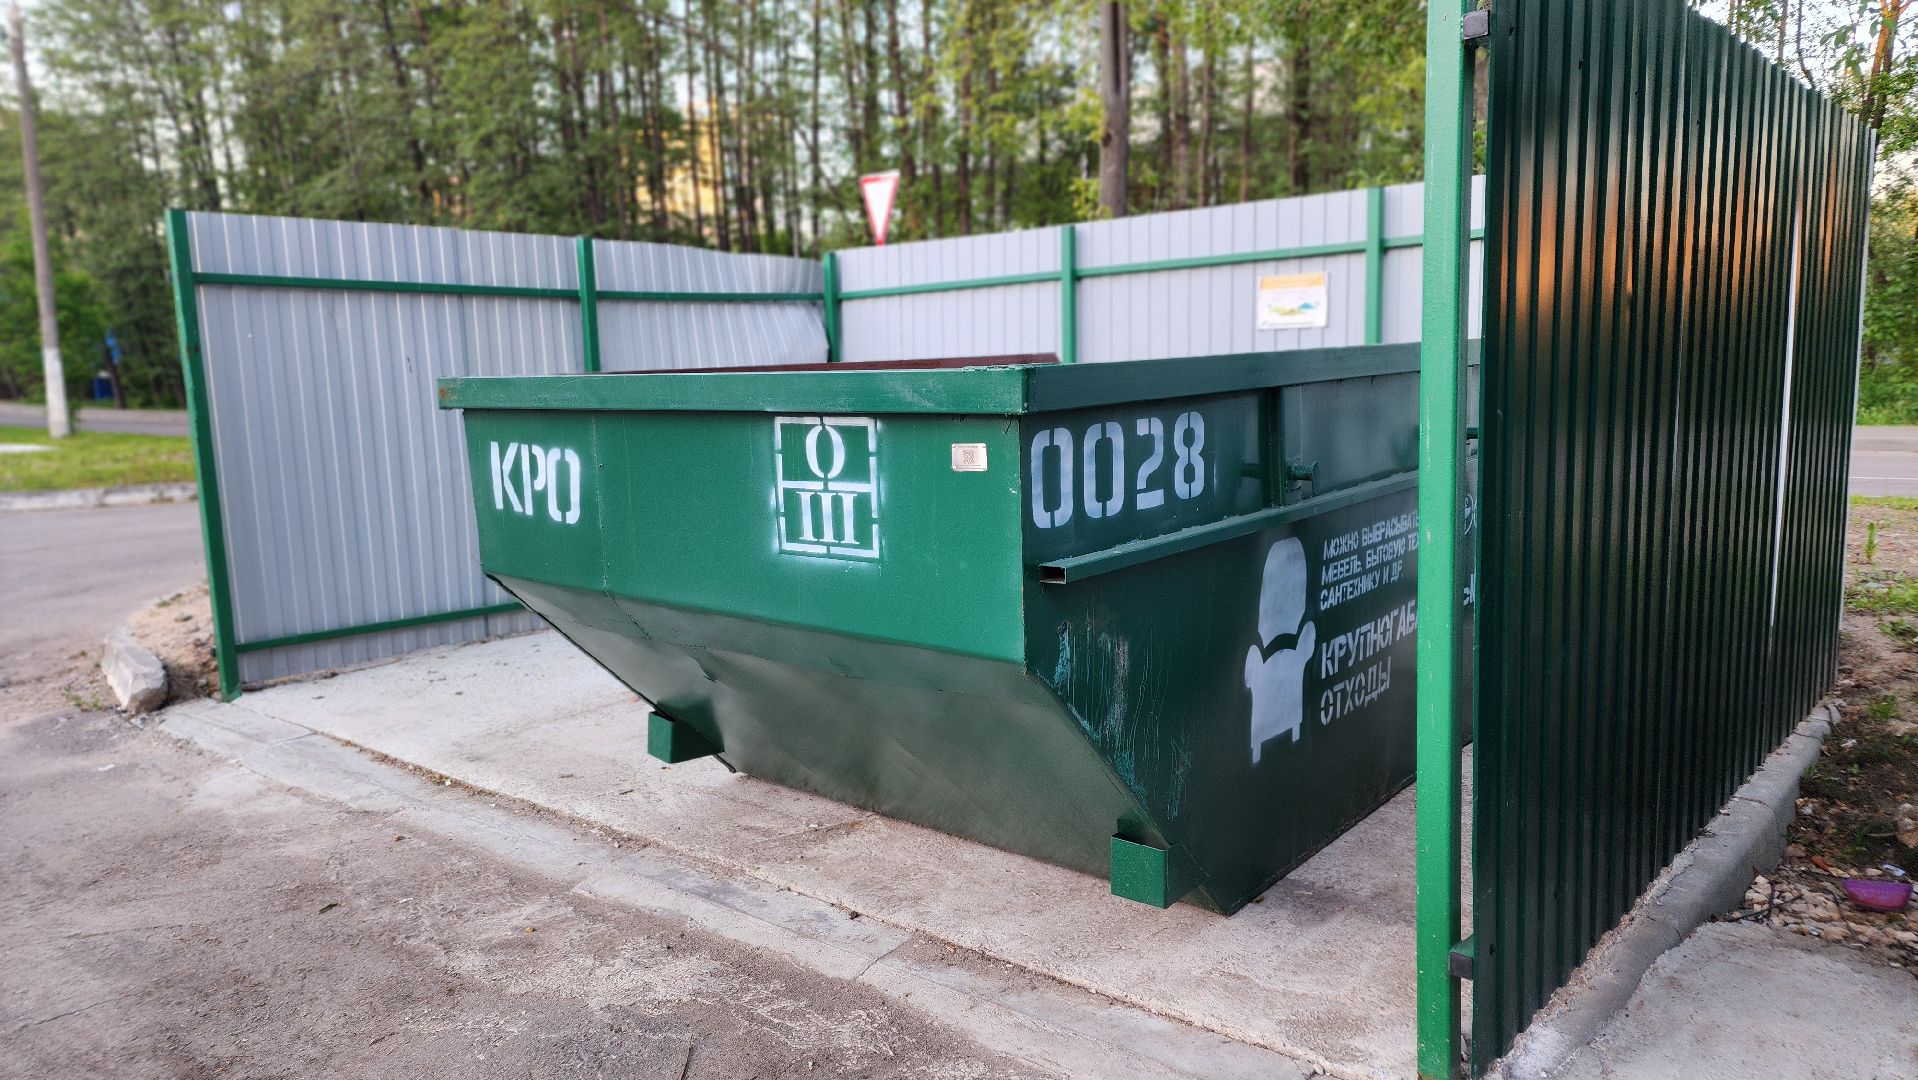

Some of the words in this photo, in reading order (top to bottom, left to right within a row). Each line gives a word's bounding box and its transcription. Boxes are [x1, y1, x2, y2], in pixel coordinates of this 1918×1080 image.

[490, 441, 581, 524] КРО
[1030, 411, 1205, 529] 0028
[1323, 530, 1359, 560] МОЖНО
[1366, 537, 1406, 569] БЫТОВУЮ
[1320, 569, 1380, 611] САНТЕХНИКУ
[1382, 565, 1390, 585] И
[1321, 600, 1418, 680] КРУПНОГАБ
[1320, 656, 1391, 726] ОТХОДЫ
